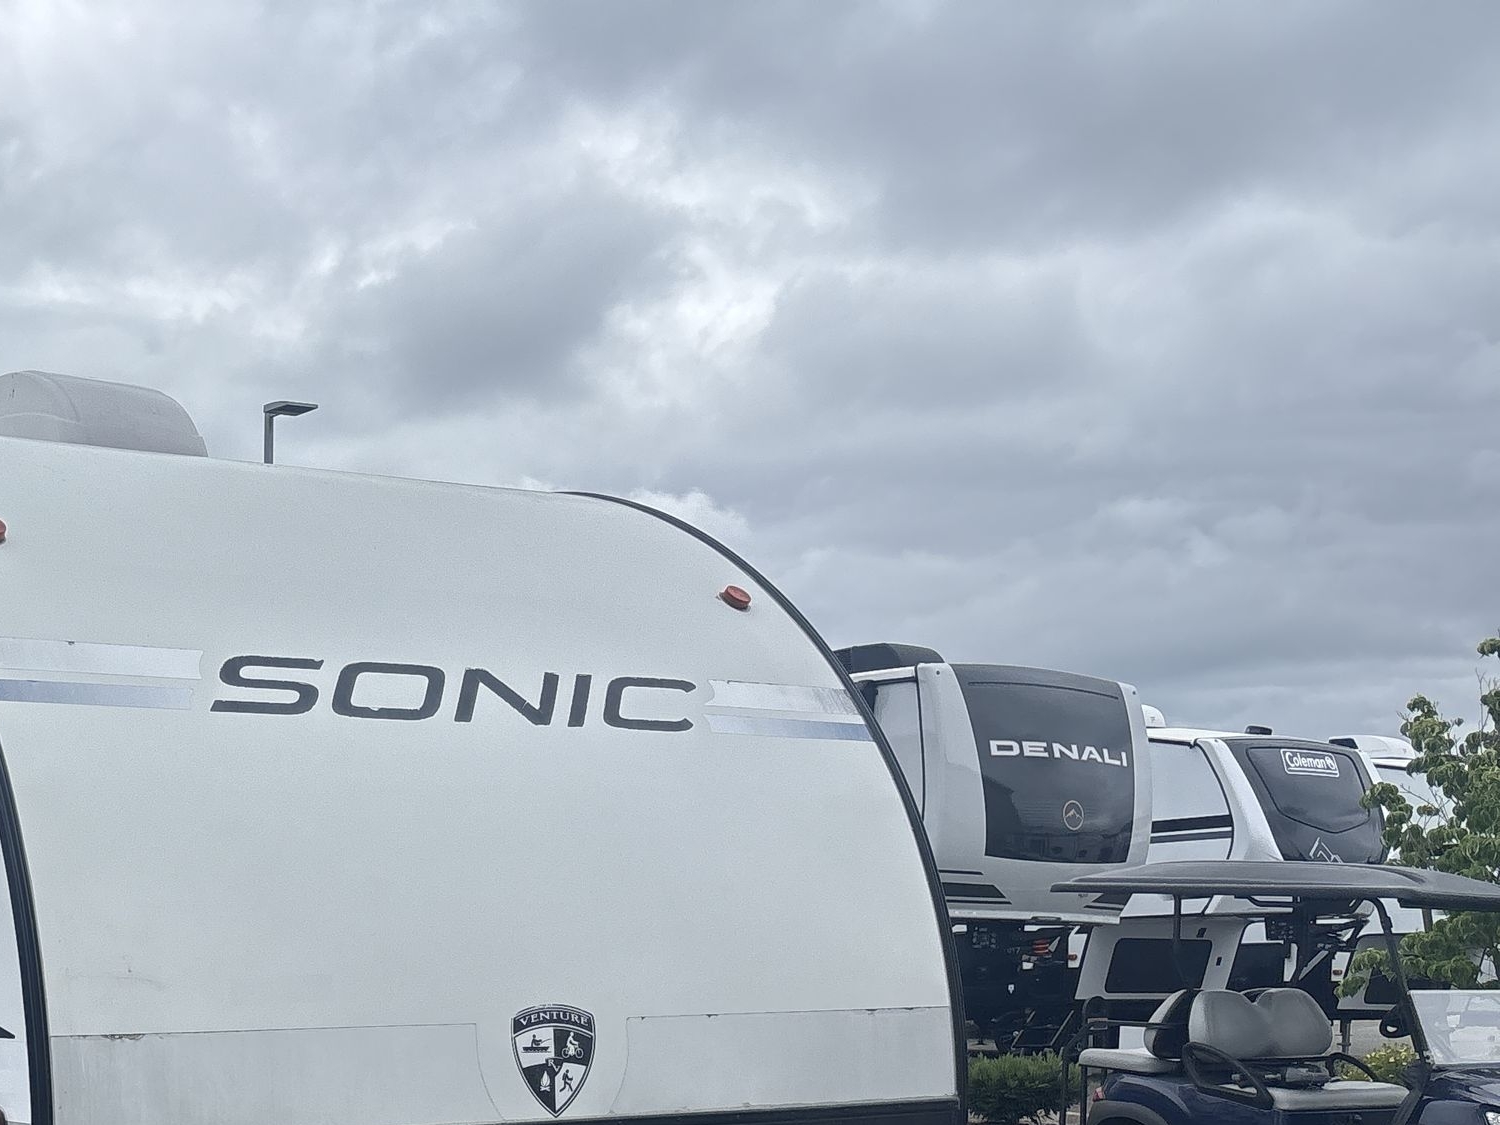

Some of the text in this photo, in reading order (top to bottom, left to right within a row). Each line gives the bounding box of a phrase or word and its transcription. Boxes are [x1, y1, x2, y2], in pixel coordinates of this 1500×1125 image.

[210, 655, 697, 732] SONIC
[989, 739, 1128, 767] DENALI
[1285, 751, 1328, 769] Coleman
[519, 1010, 589, 1027] VENTURE
[547, 1059, 561, 1073] RV
